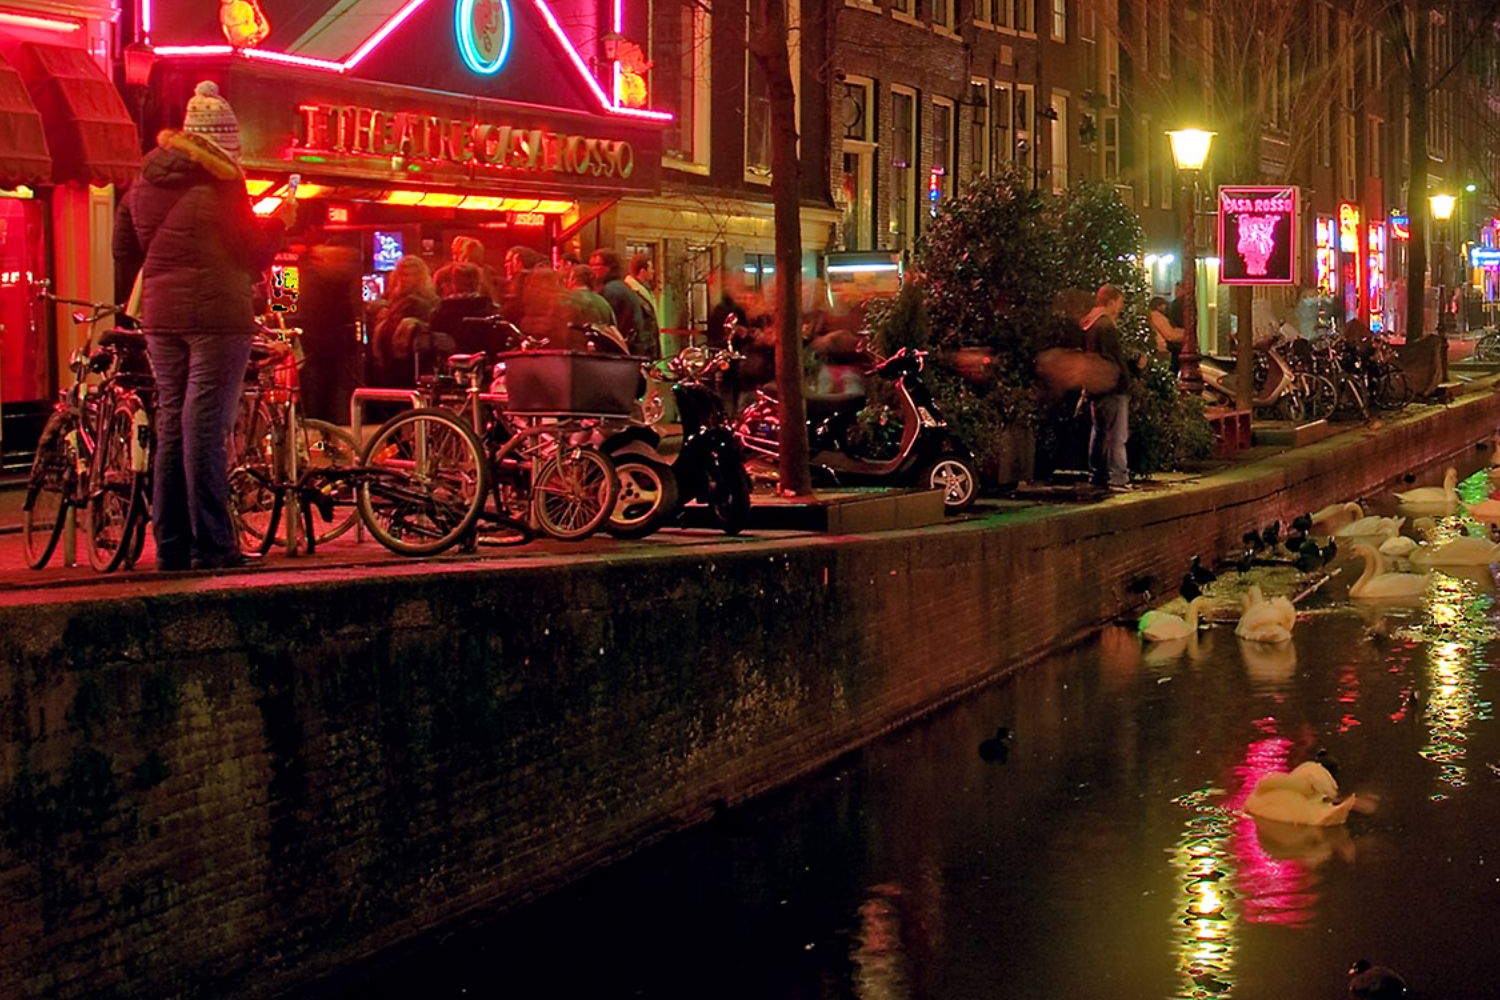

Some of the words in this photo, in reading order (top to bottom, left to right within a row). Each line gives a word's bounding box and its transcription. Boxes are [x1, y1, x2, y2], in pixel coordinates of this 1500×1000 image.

[543, 132, 634, 180] ROSSO
[1223, 198, 1253, 213] CASA
[1254, 198, 1293, 213] ROSSO
